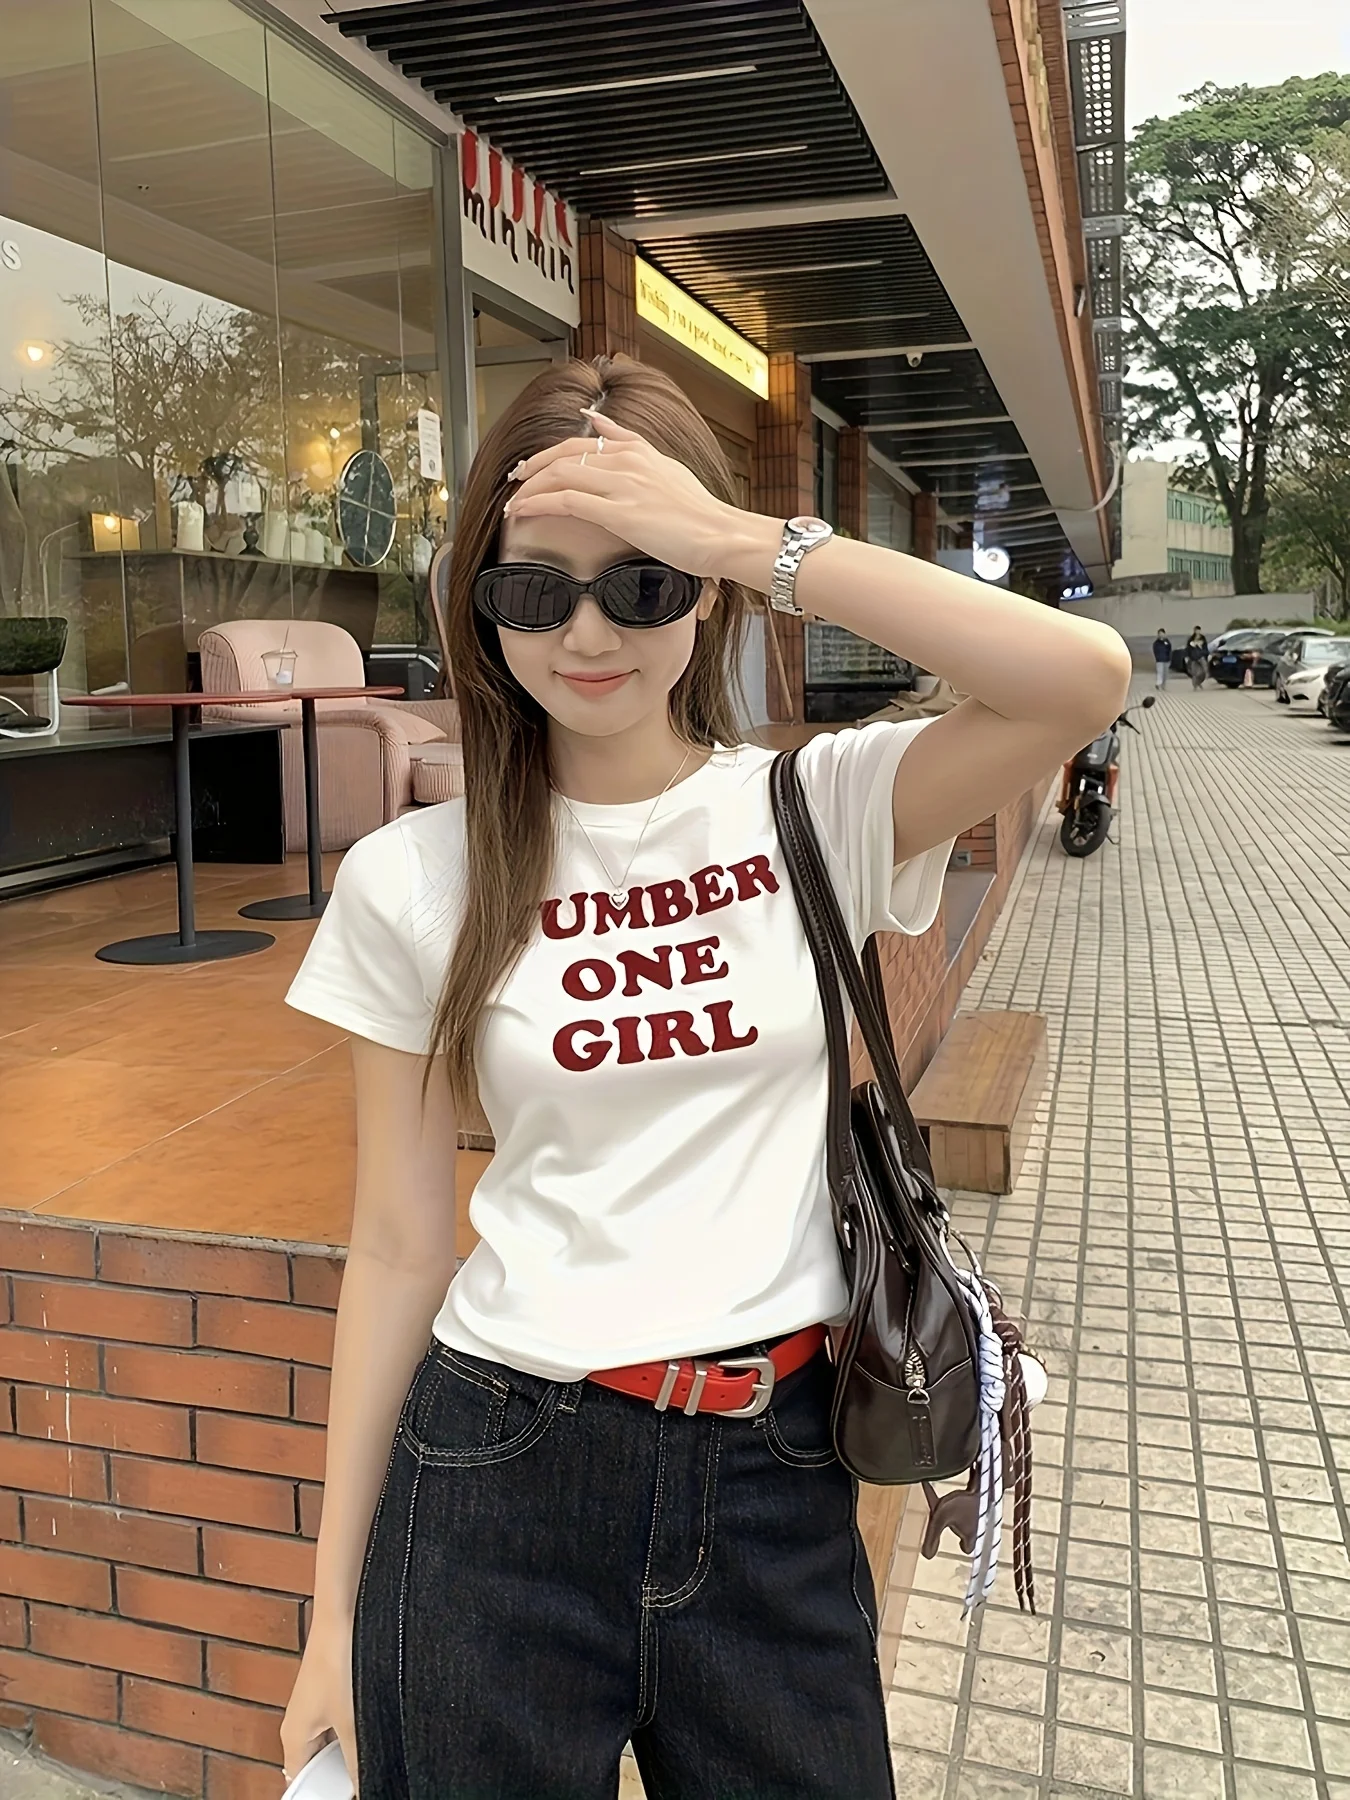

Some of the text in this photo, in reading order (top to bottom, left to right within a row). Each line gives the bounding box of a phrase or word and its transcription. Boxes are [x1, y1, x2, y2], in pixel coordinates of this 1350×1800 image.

[538, 854, 780, 940] UMBER
[561, 935, 730, 1002] ONE
[552, 999, 759, 1072] GIRL
